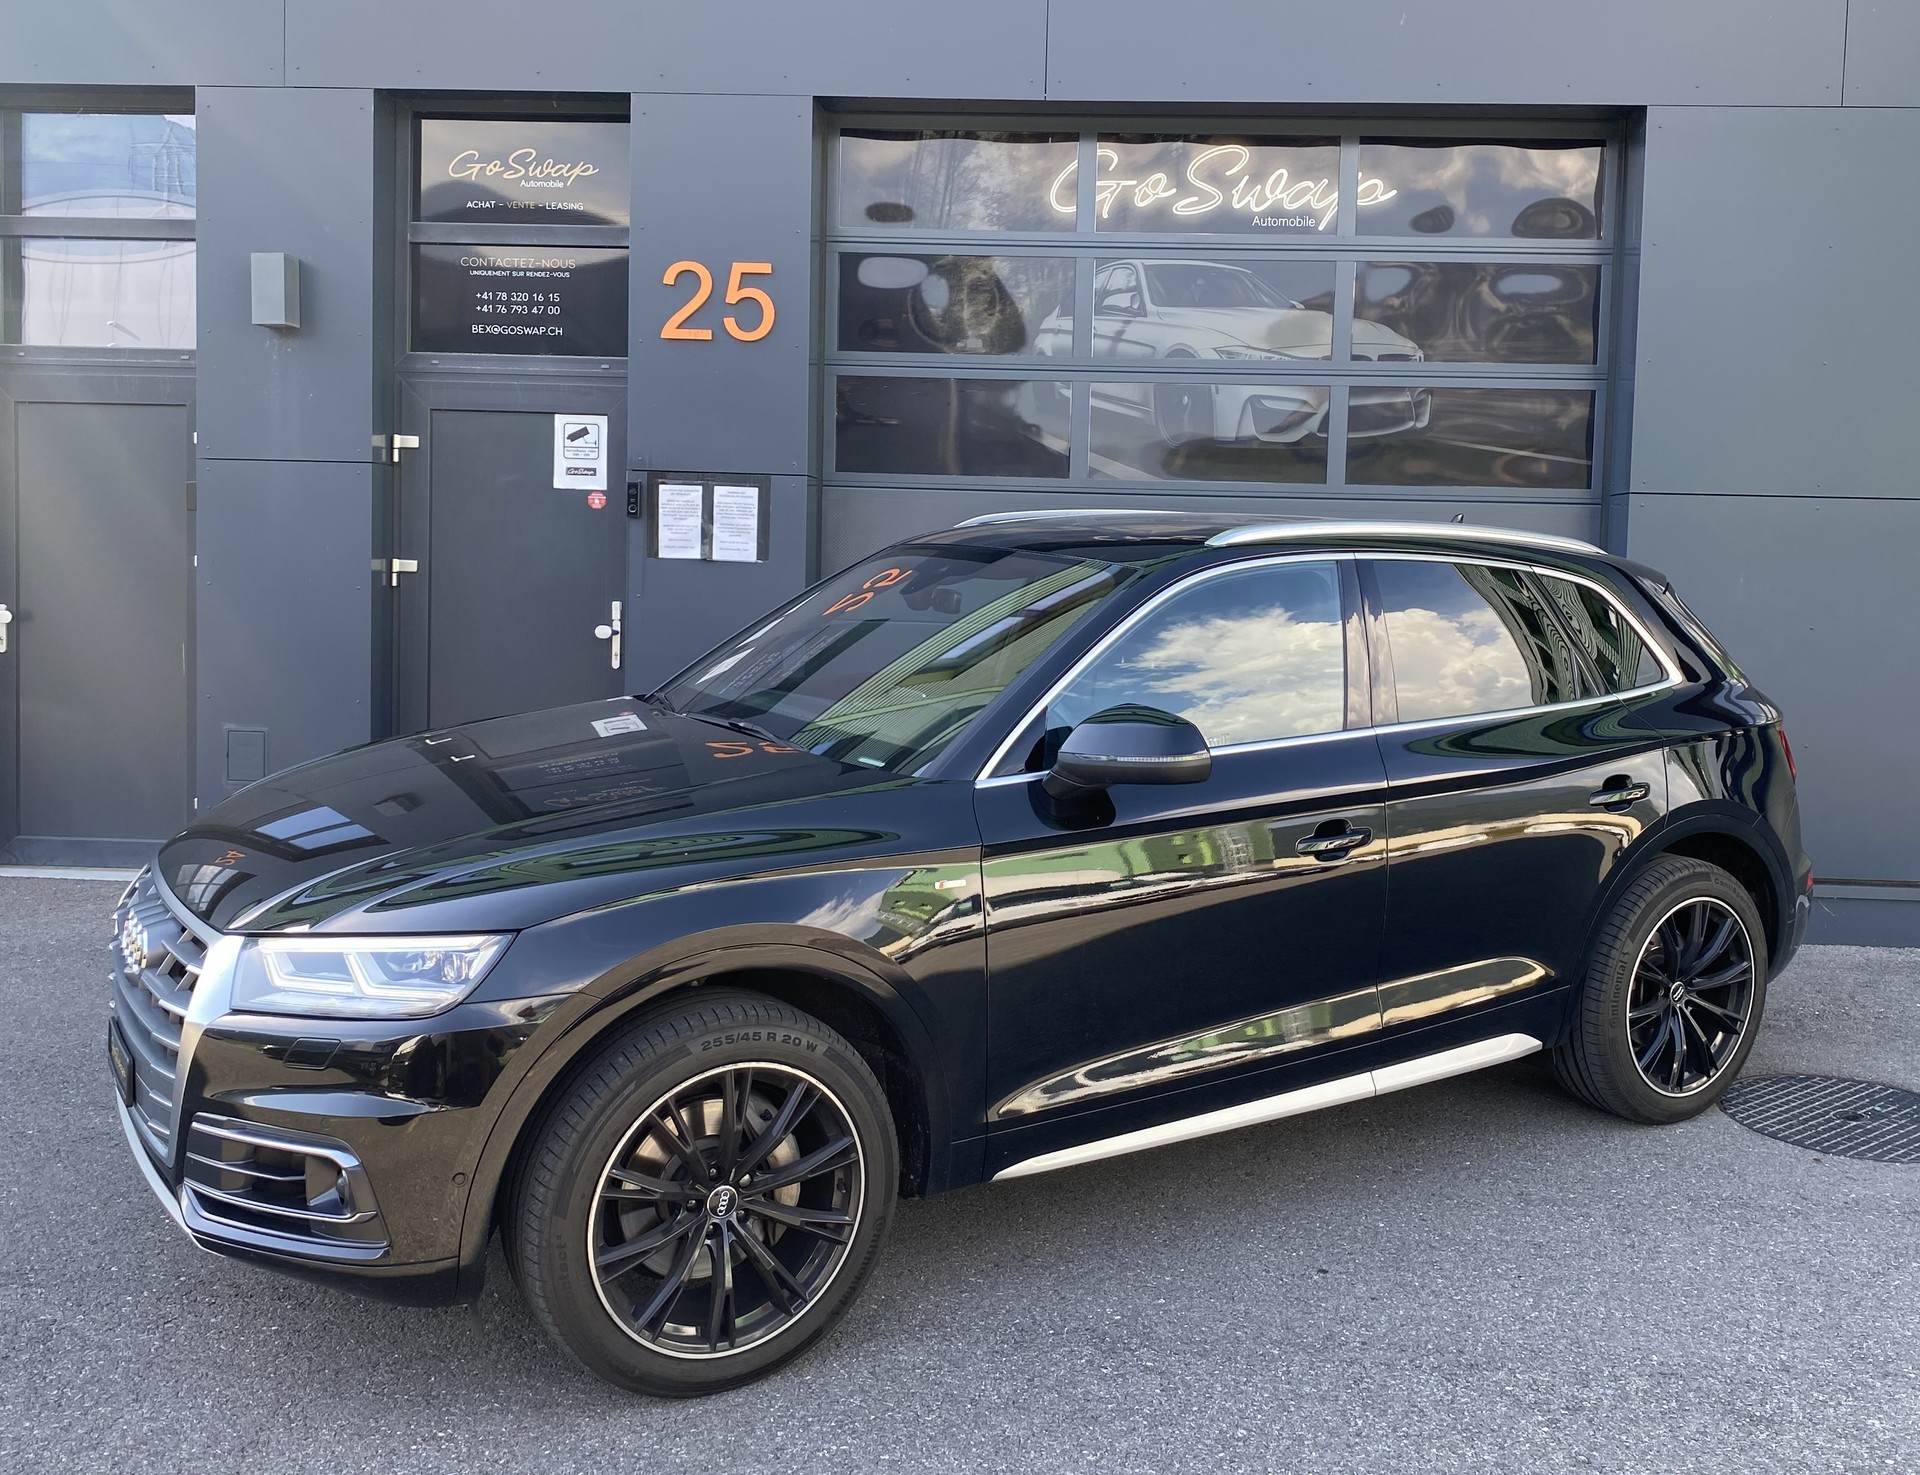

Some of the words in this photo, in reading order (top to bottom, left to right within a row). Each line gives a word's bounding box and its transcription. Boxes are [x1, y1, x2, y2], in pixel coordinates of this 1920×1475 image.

[520, 180, 564, 188] Automobile
[466, 201, 496, 209] ACHAT
[506, 202, 536, 210] VENTE
[546, 202, 584, 211] LEASING
[1252, 216, 1316, 228] Automobile
[460, 257, 576, 269] CONTACTEZ-NOUS
[475, 292, 493, 300] +41
[496, 292, 508, 301] 78
[510, 293, 529, 302] 320
[533, 293, 544, 302] 16
[549, 293, 560, 302] 15
[660, 261, 776, 342] 25
[475, 305, 493, 313] +41
[496, 305, 508, 314] 76
[510, 306, 528, 315] 793
[531, 306, 544, 315] 47
[548, 306, 561, 315] 00
[472, 325, 563, 336] BEX@GOSWAP.CH
[701, 1032, 762, 1052] 255/45
[766, 1032, 777, 1042] R
[780, 1035, 801, 1047] 20
[806, 1040, 818, 1052] W
